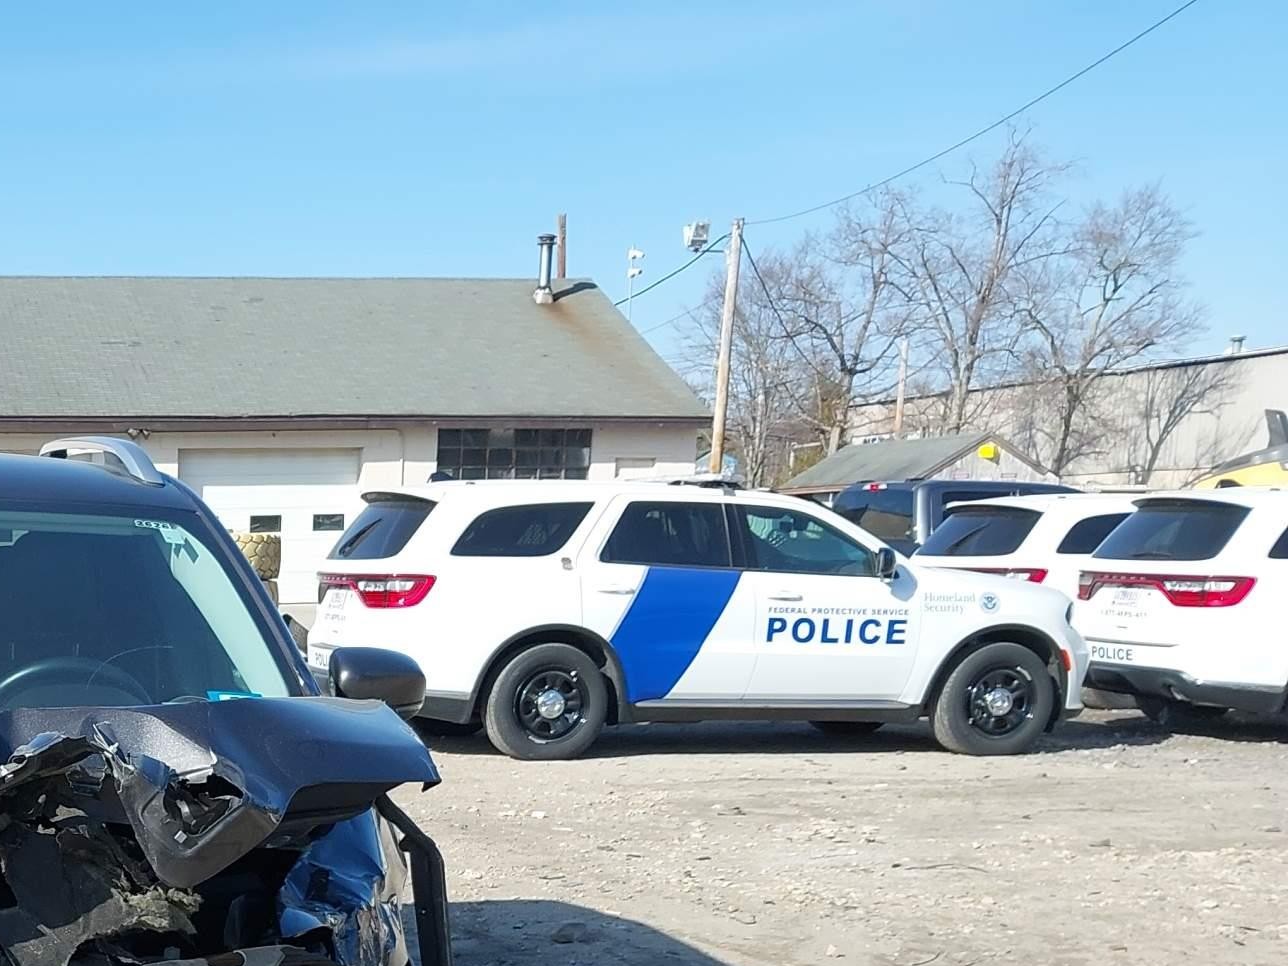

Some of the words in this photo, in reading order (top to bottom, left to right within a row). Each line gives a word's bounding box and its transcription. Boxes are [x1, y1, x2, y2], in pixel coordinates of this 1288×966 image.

[924, 592, 976, 602] Homeland
[768, 606, 808, 614] FEDERAL
[812, 607, 867, 615] PROTECTIVE
[871, 608, 909, 616] SERVICE
[924, 603, 964, 615] Security
[766, 617, 908, 644] POLICE
[315, 652, 329, 667] POLI
[1091, 646, 1133, 661] POLICE
